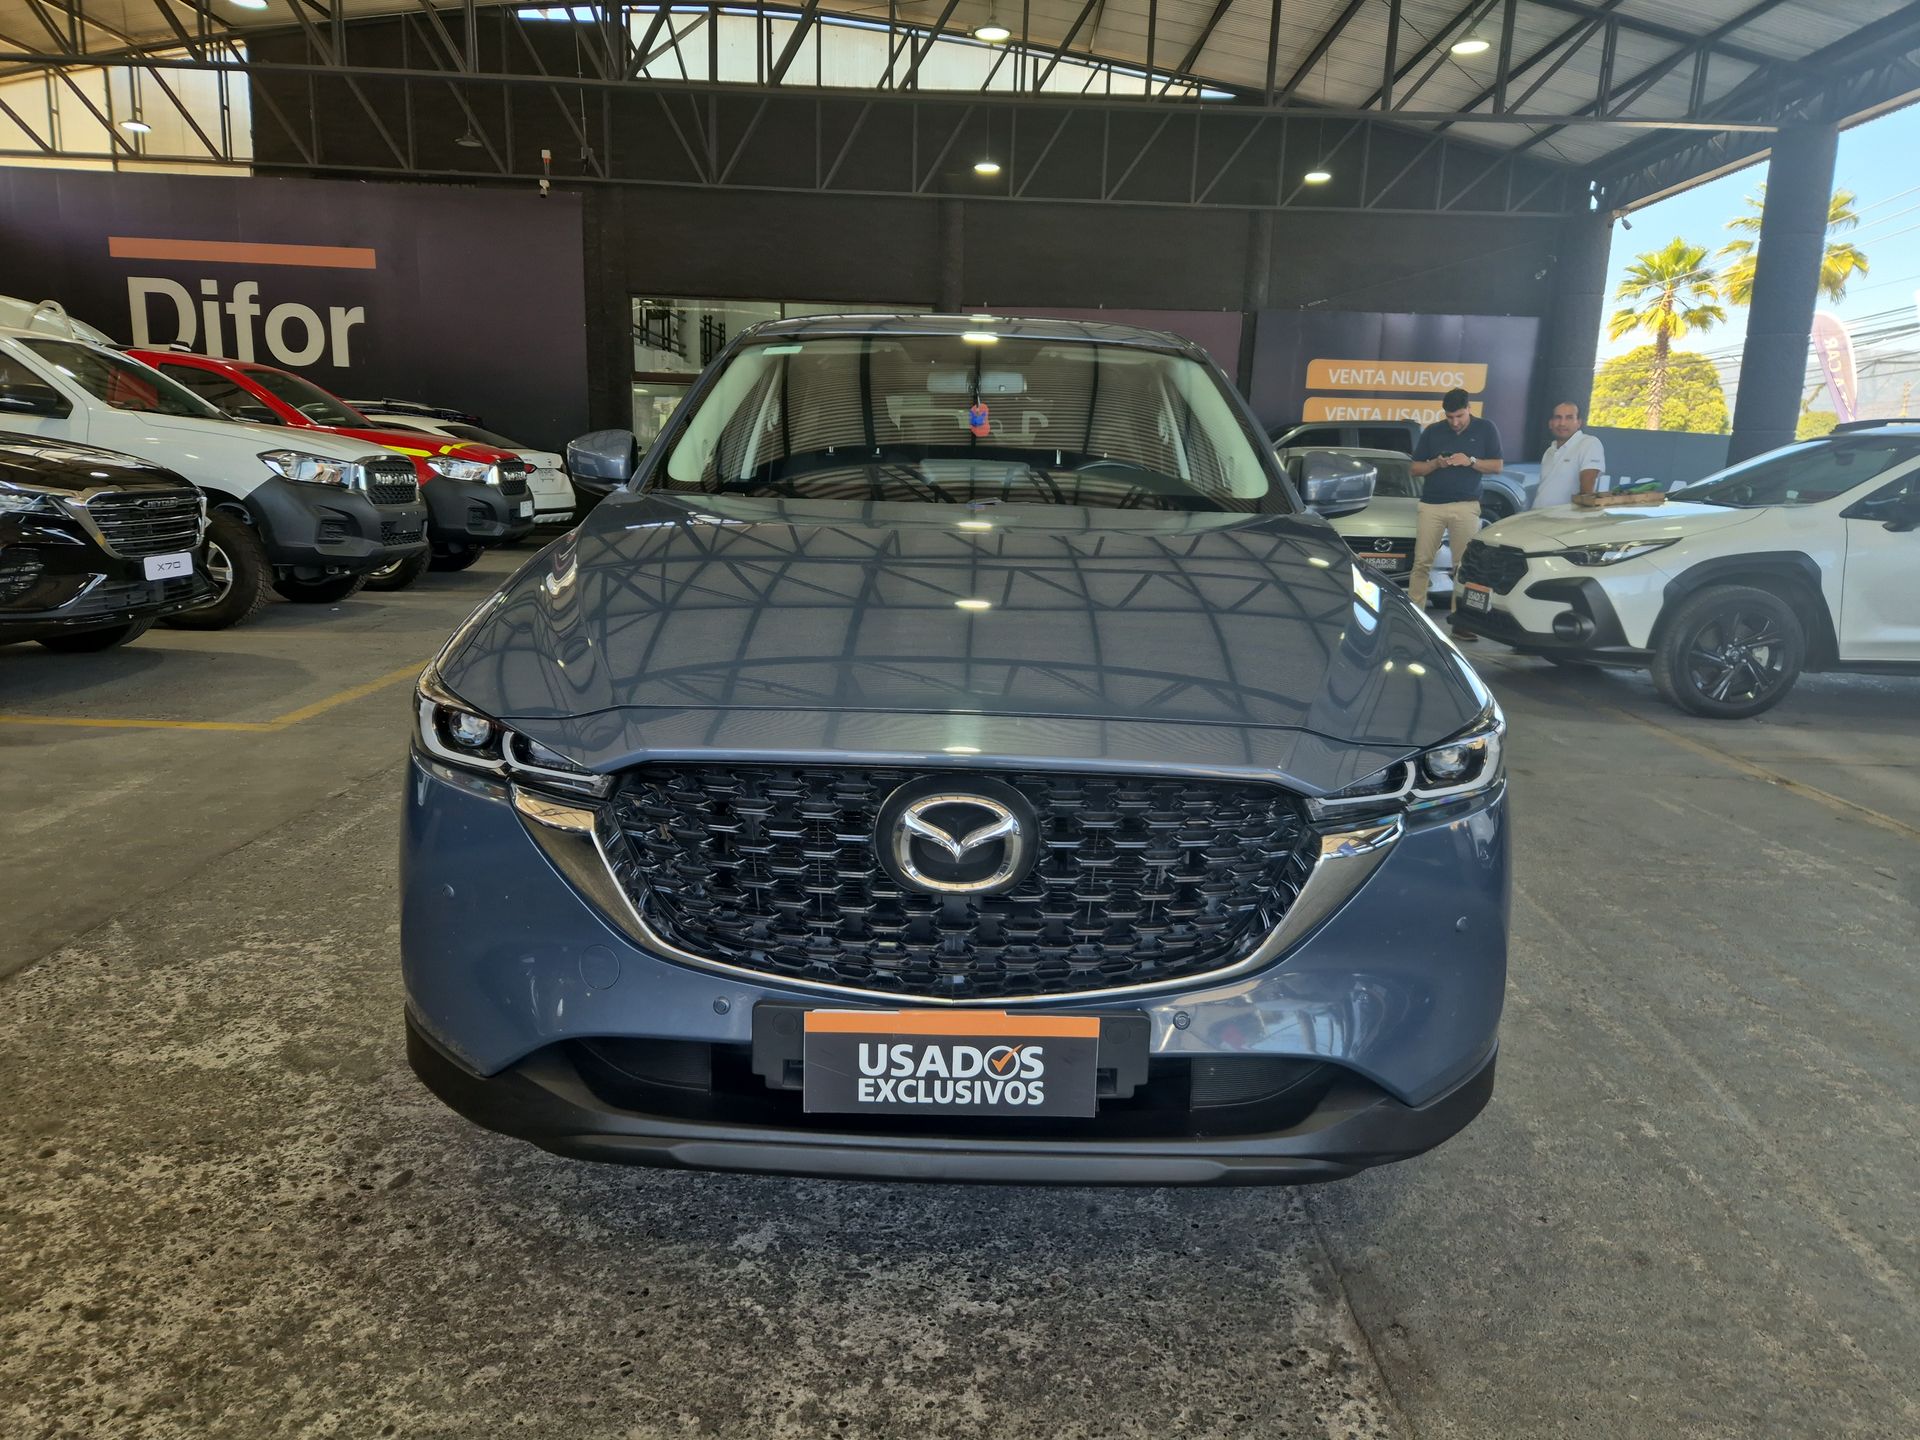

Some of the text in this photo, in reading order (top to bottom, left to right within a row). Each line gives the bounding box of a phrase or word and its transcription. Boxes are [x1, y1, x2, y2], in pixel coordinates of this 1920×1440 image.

[127, 276, 365, 368] Difor
[1328, 368, 1465, 387] VENTA NUEVOS
[1325, 406, 1447, 425] VENTA USADO
[157, 561, 181, 571] X70
[858, 1043, 1045, 1080] USADOS
[858, 1078, 1045, 1106] EXCLUSIVOS
